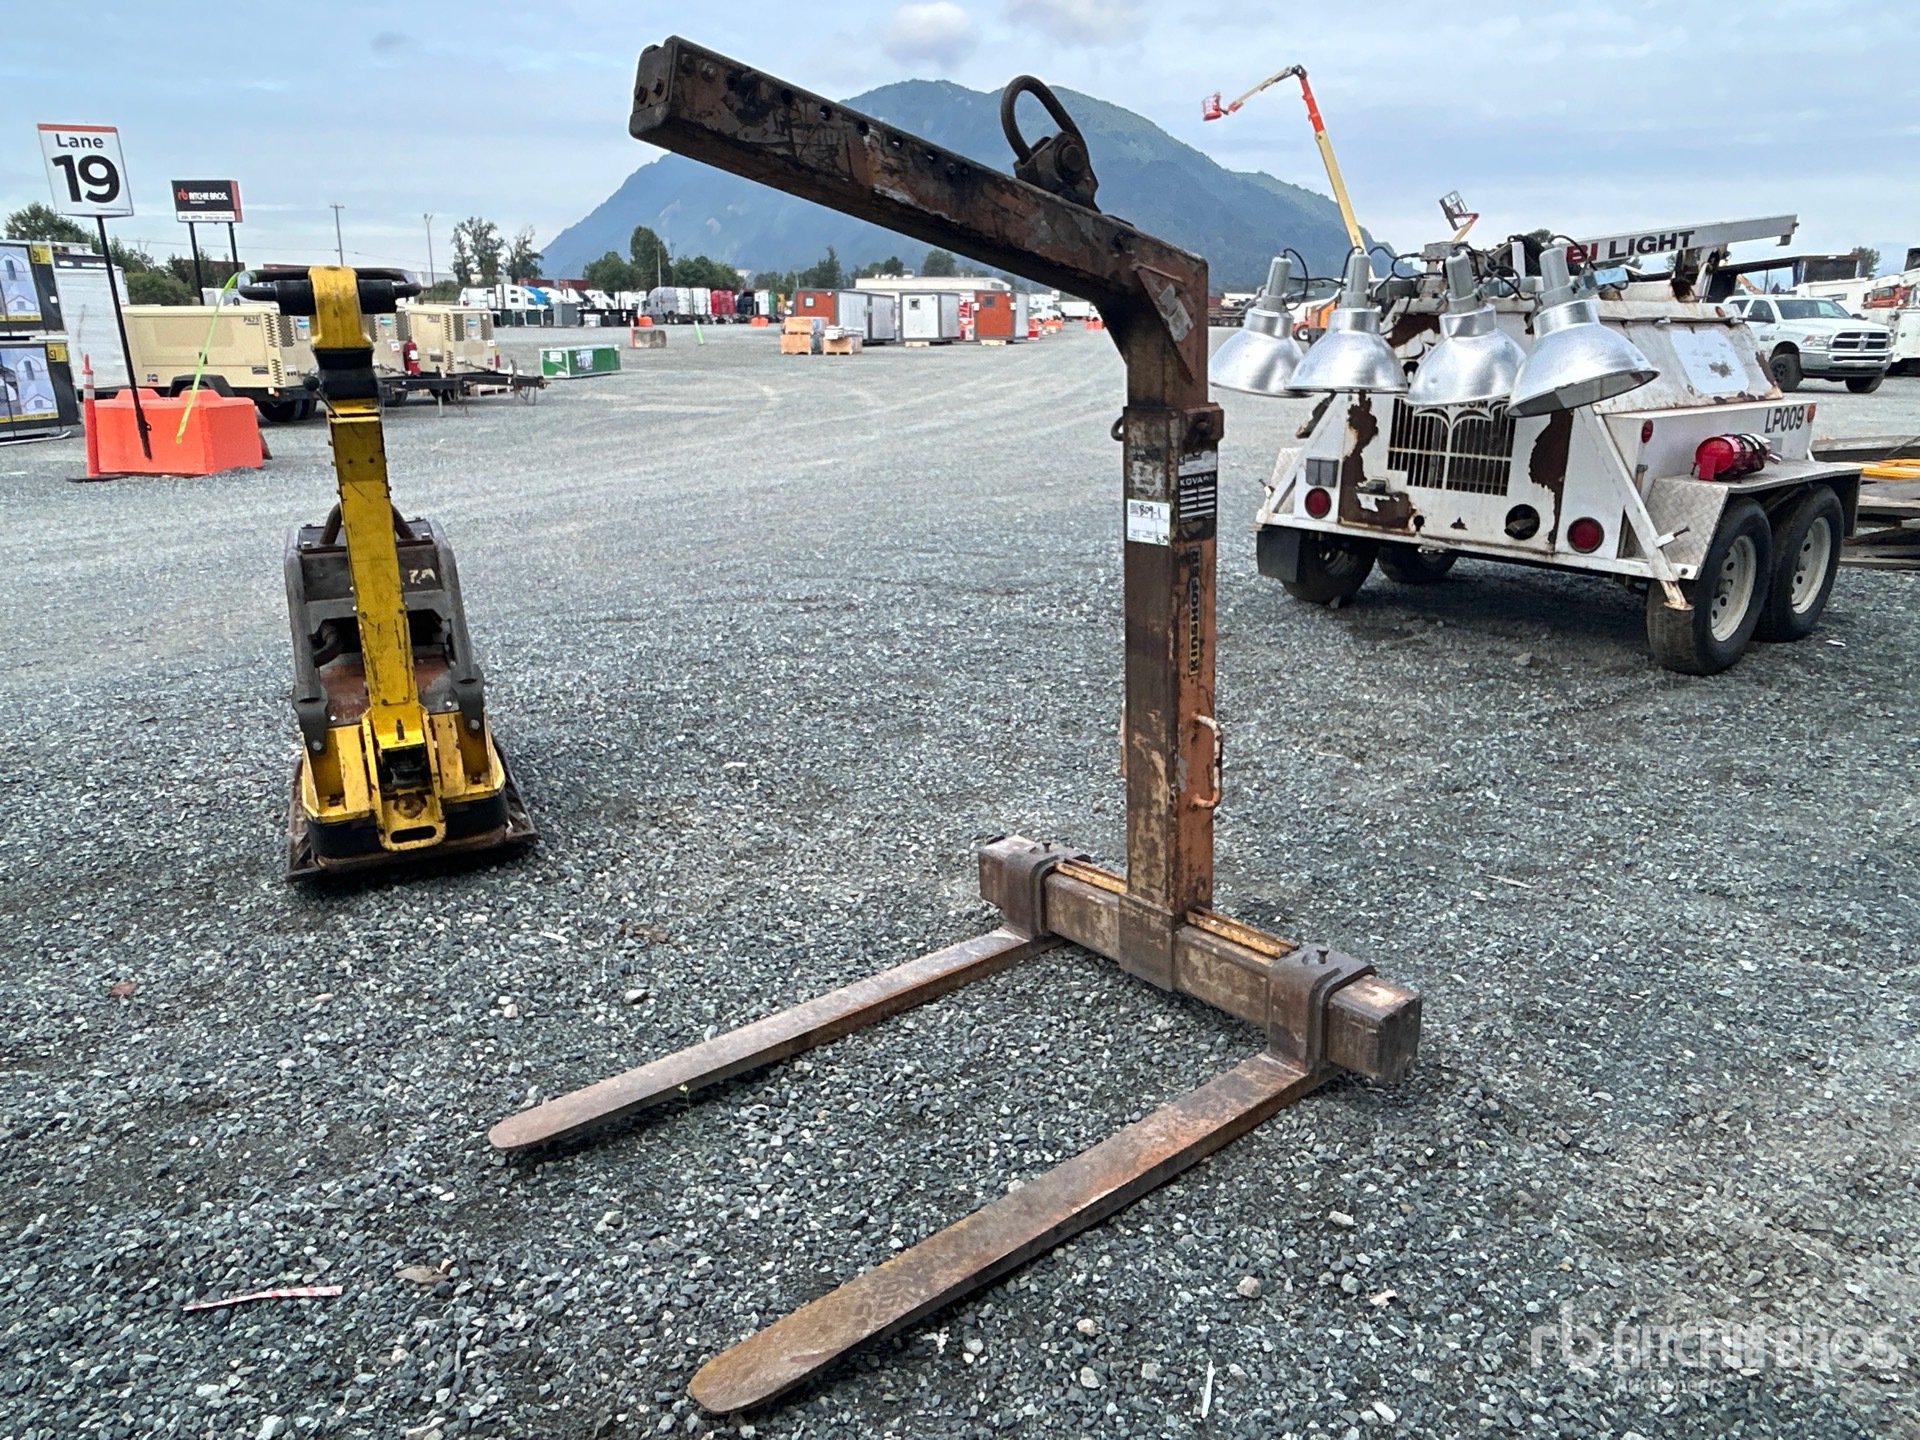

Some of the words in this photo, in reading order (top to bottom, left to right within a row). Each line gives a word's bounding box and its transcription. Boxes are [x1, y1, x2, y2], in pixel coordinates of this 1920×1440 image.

[55, 133, 104, 149] Lane
[51, 154, 120, 204] 19
[1608, 230, 1695, 260] LIGHT
[1764, 405, 1805, 434] LP009
